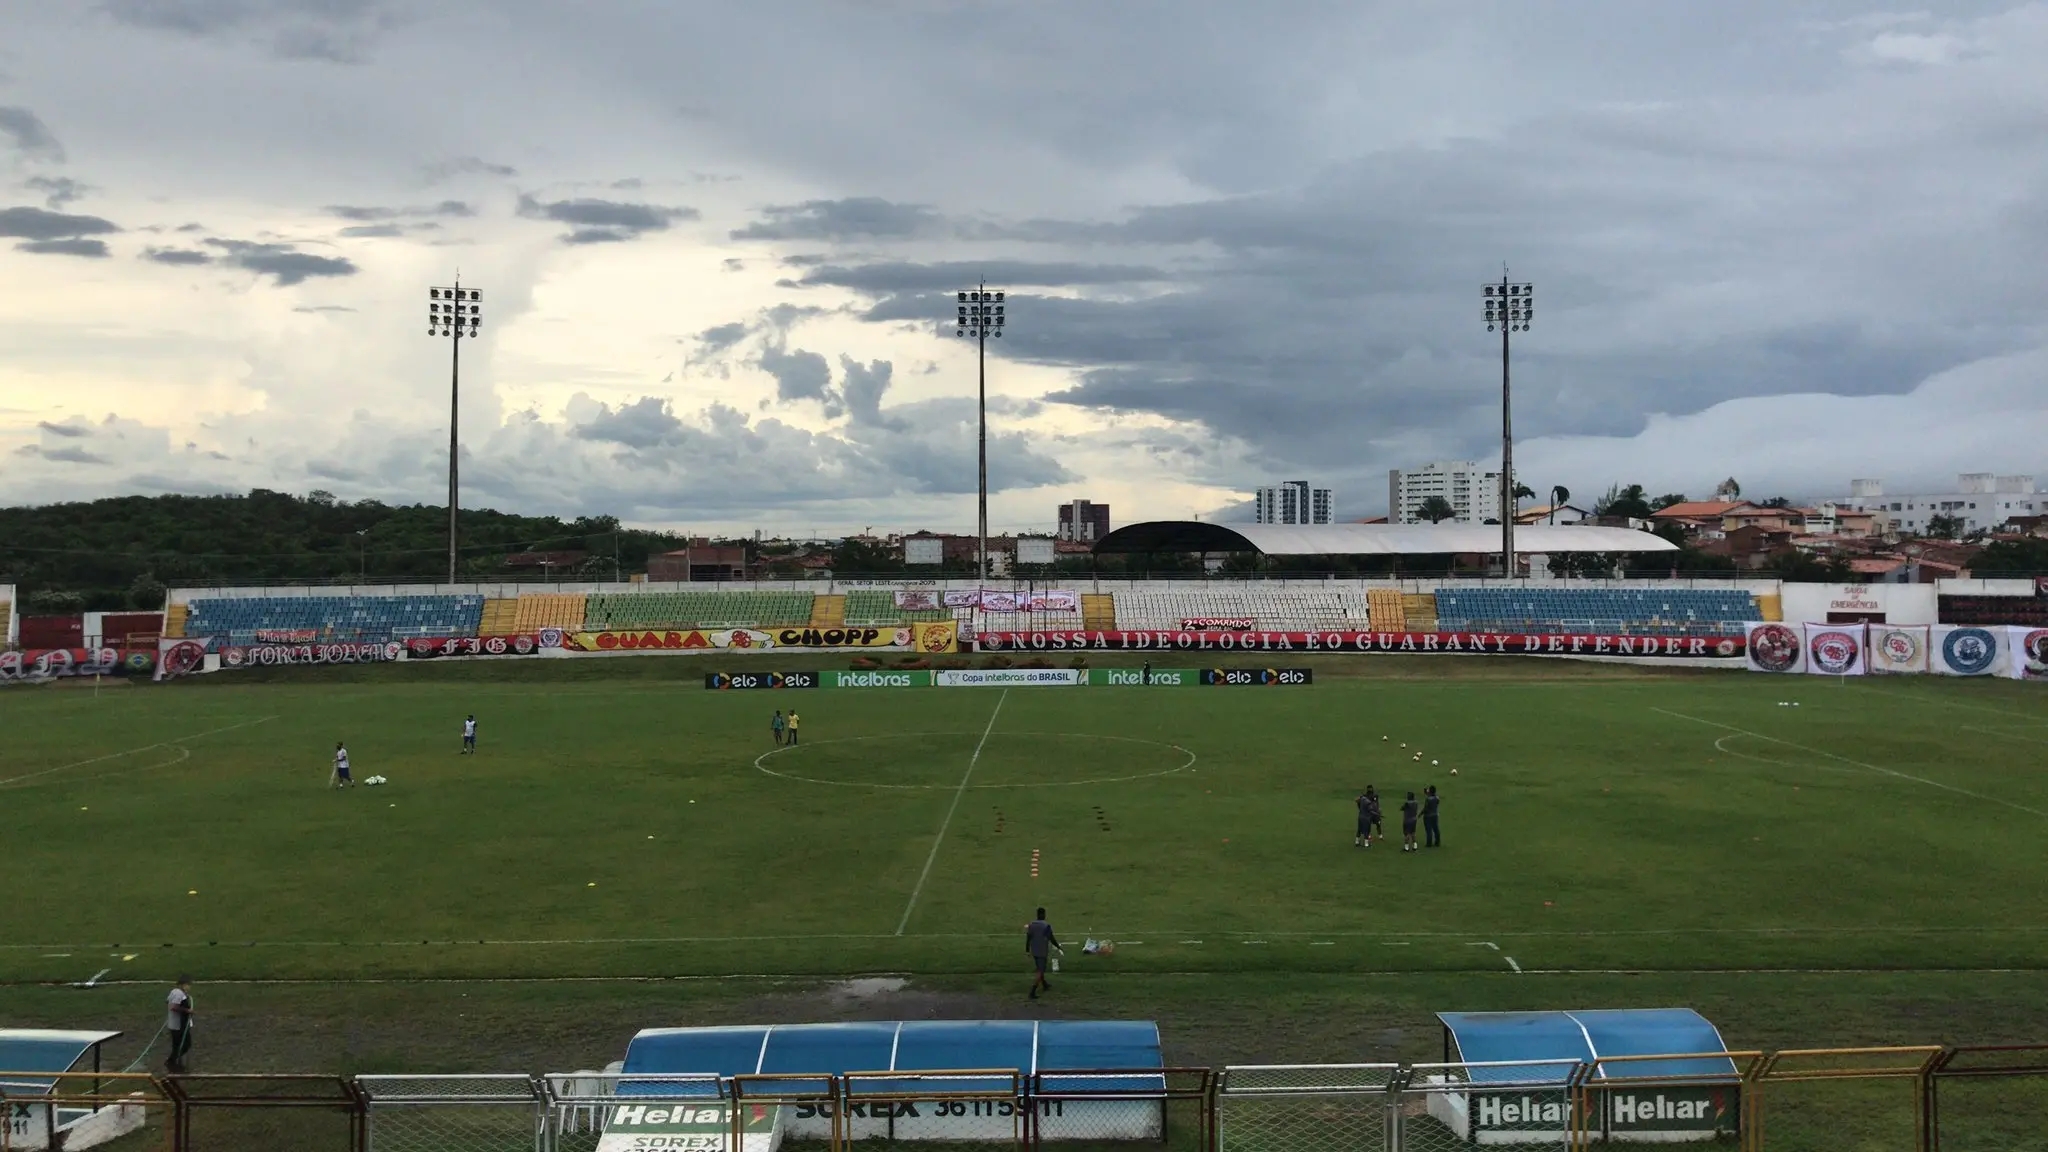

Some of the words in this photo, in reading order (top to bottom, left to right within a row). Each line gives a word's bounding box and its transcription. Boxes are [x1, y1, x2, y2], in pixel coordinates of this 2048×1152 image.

[1199, 618, 1252, 628] COMANDO
[596, 630, 707, 648] GUARA
[779, 629, 878, 646] CHOPP
[1009, 631, 1108, 649] NOSSA
[1120, 632, 1293, 650] IDEOLOGIA
[1355, 633, 1510, 651] GUARANY
[1524, 635, 1706, 655] DEFENDER
[732, 674, 757, 688] elo
[785, 673, 810, 687] elo
[837, 672, 911, 687] intelbras
[962, 673, 983, 683] Copa
[985, 673, 1025, 682] intelbras
[1027, 673, 1038, 681] do
[1039, 672, 1071, 681] BRASIL
[1227, 670, 1251, 684] elo
[1279, 670, 1304, 684] elo
[1614, 1094, 1709, 1123] Heliar
[634, 1136, 720, 1148] SOREX
